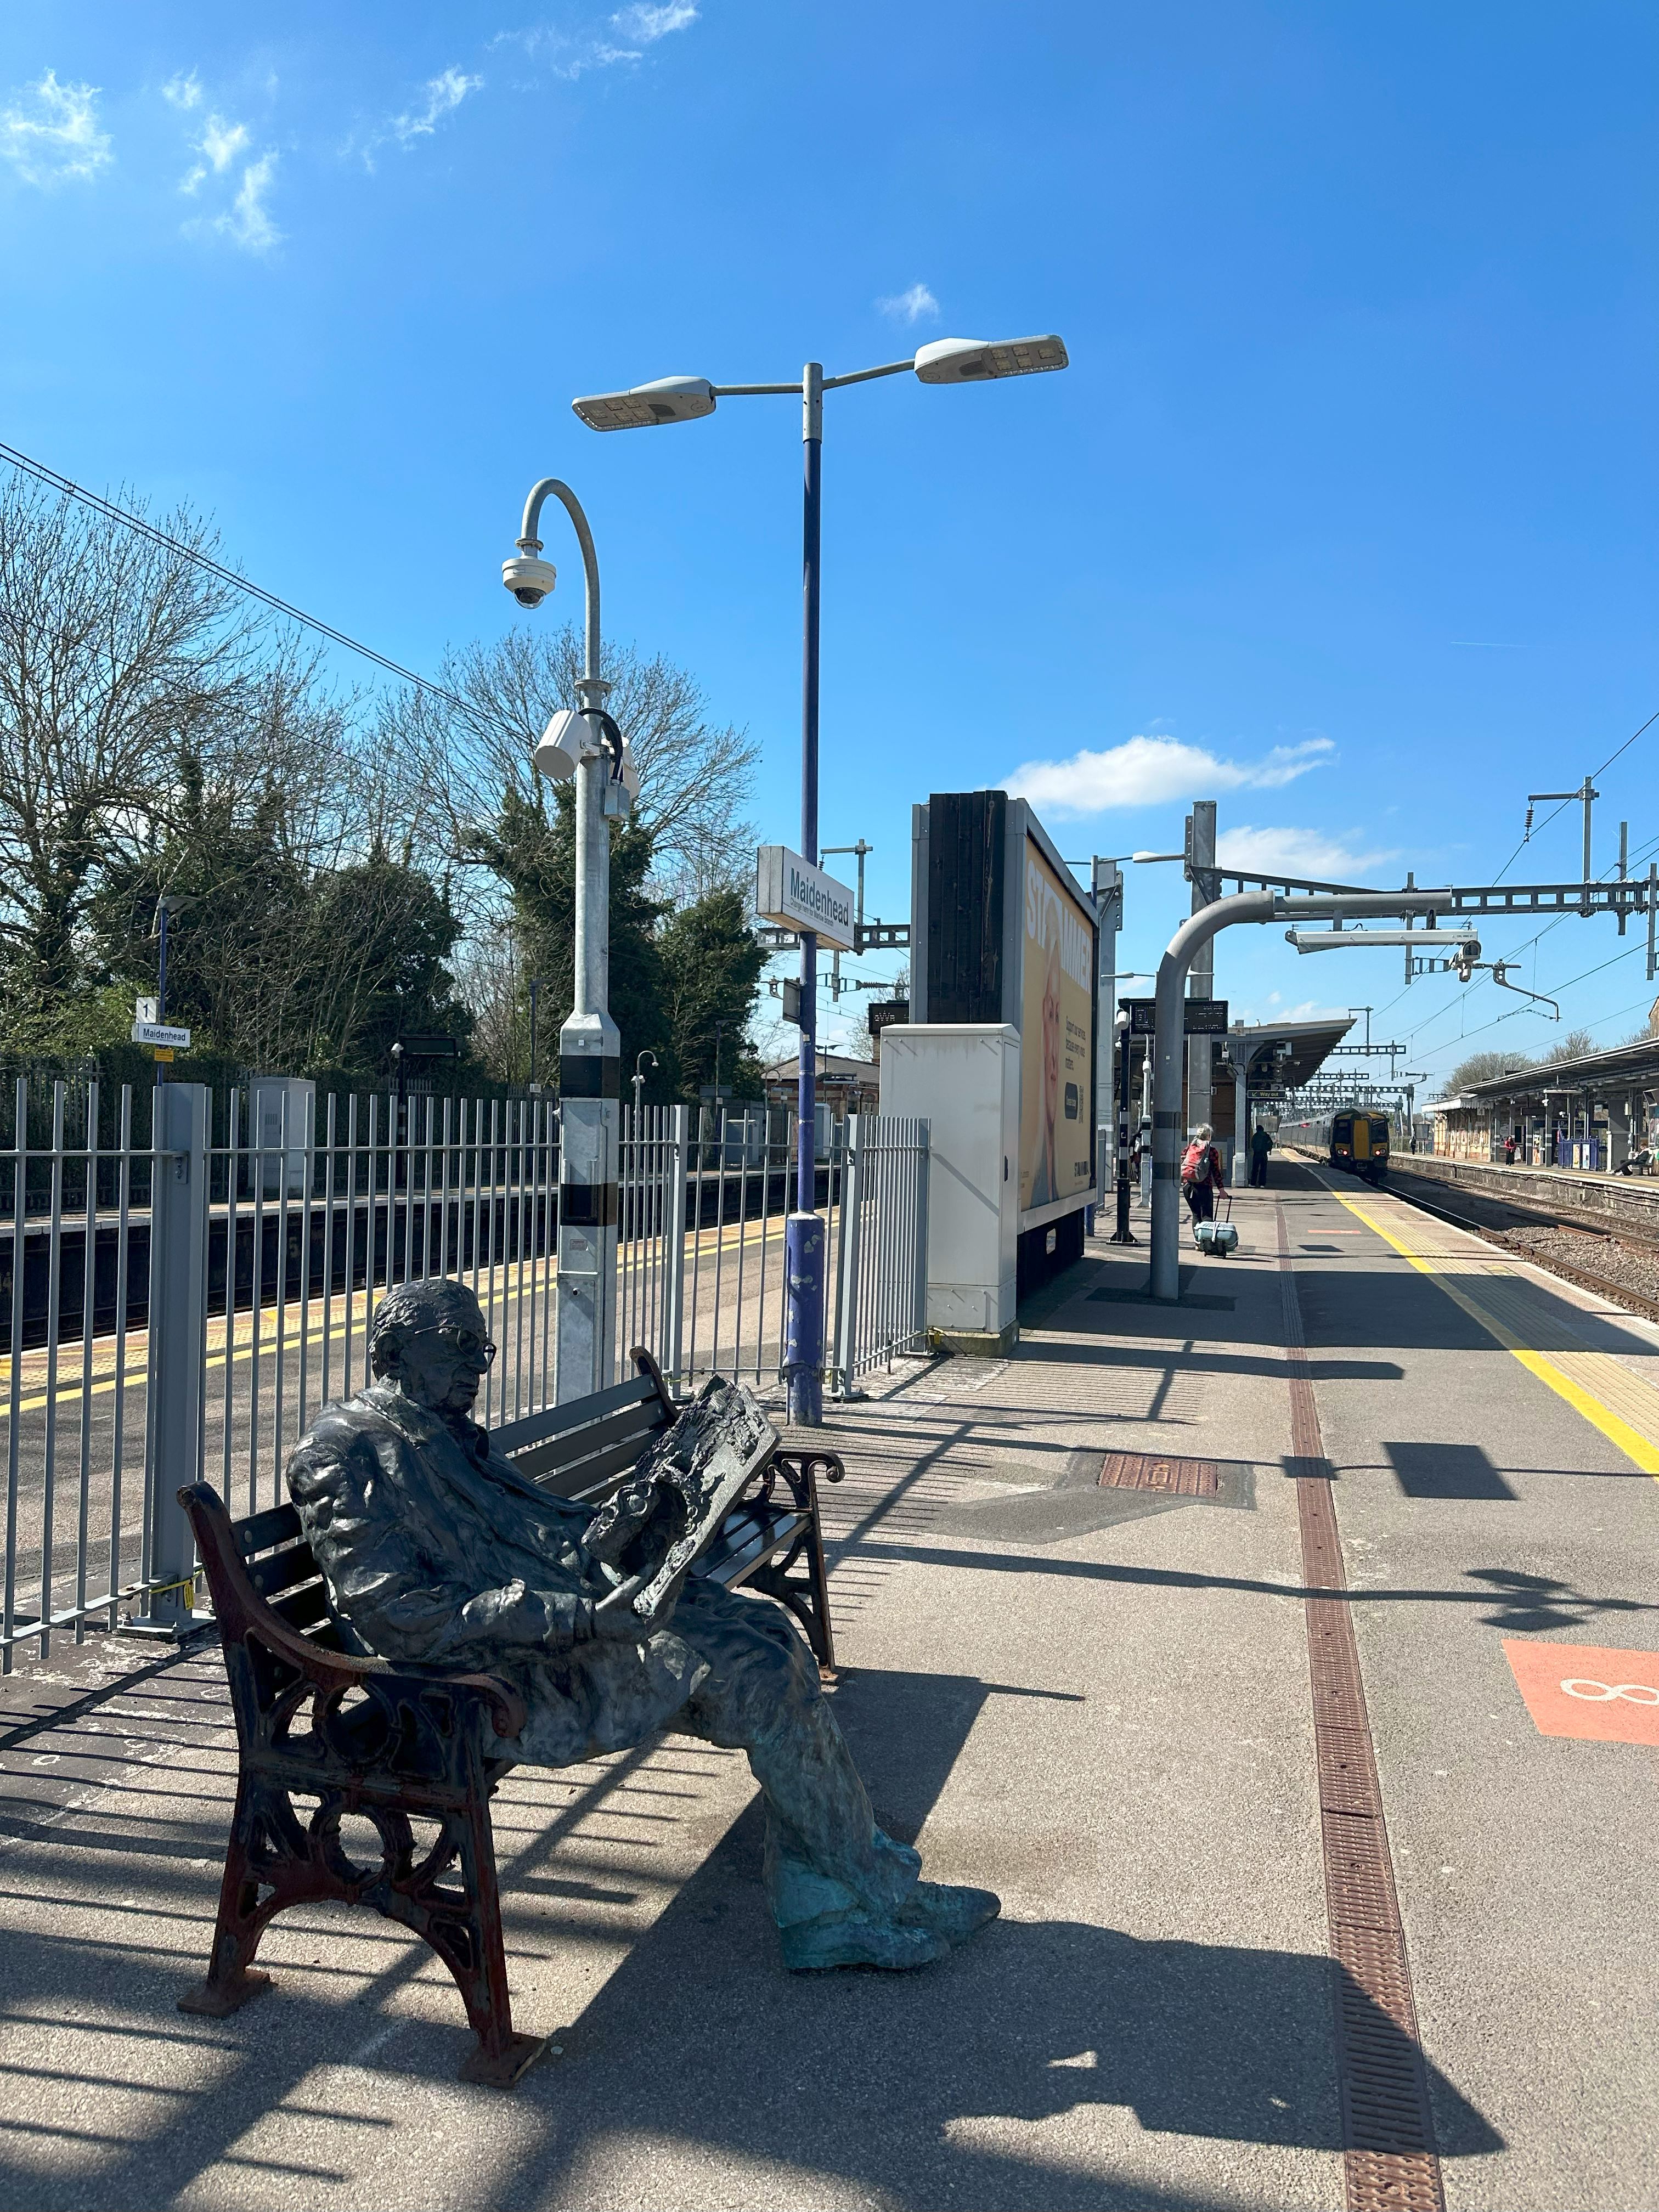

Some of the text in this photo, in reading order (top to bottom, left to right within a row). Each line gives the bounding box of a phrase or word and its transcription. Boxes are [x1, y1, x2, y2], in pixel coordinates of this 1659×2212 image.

[791, 867, 849, 927] Maidenhead
[143, 1003, 148, 1018] 1
[143, 1028, 186, 1041] Maidenhead
